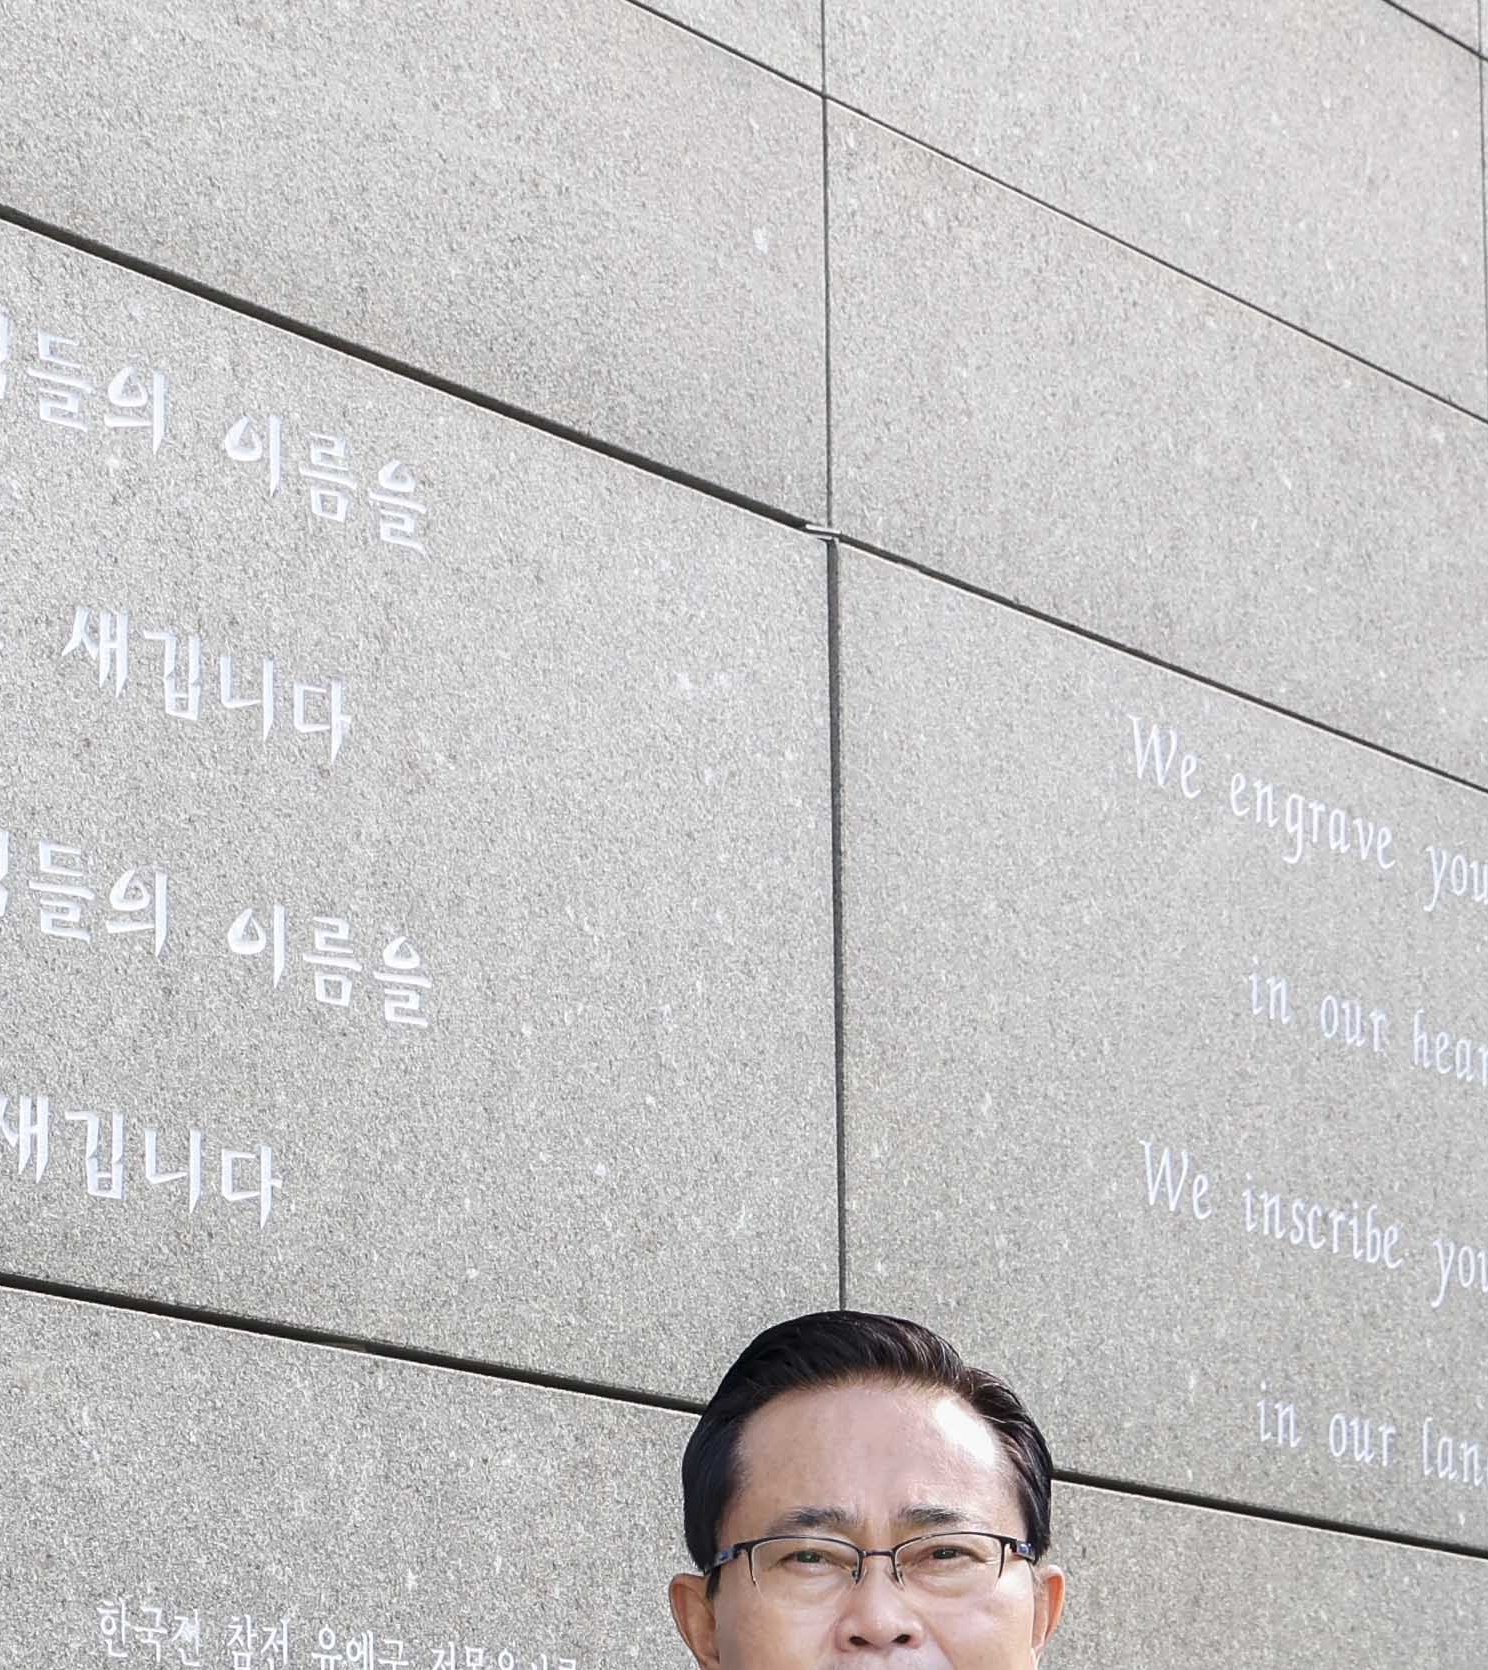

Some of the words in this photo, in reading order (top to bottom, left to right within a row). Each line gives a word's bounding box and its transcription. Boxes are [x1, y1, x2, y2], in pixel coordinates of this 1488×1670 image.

[222, 413, 429, 555] 이름을
[60, 605, 353, 765] 새깁니다
[1127, 714, 1202, 799] We
[1229, 769, 1396, 864] engrave
[226, 902, 432, 1027] 이름을
[1248, 955, 1292, 1024] in
[1319, 988, 1388, 1055] our
[1139, 1139, 1213, 1220] We
[1241, 1173, 1403, 1271] inscribe
[1256, 1381, 1301, 1450] in
[1328, 1411, 1397, 1468] our
